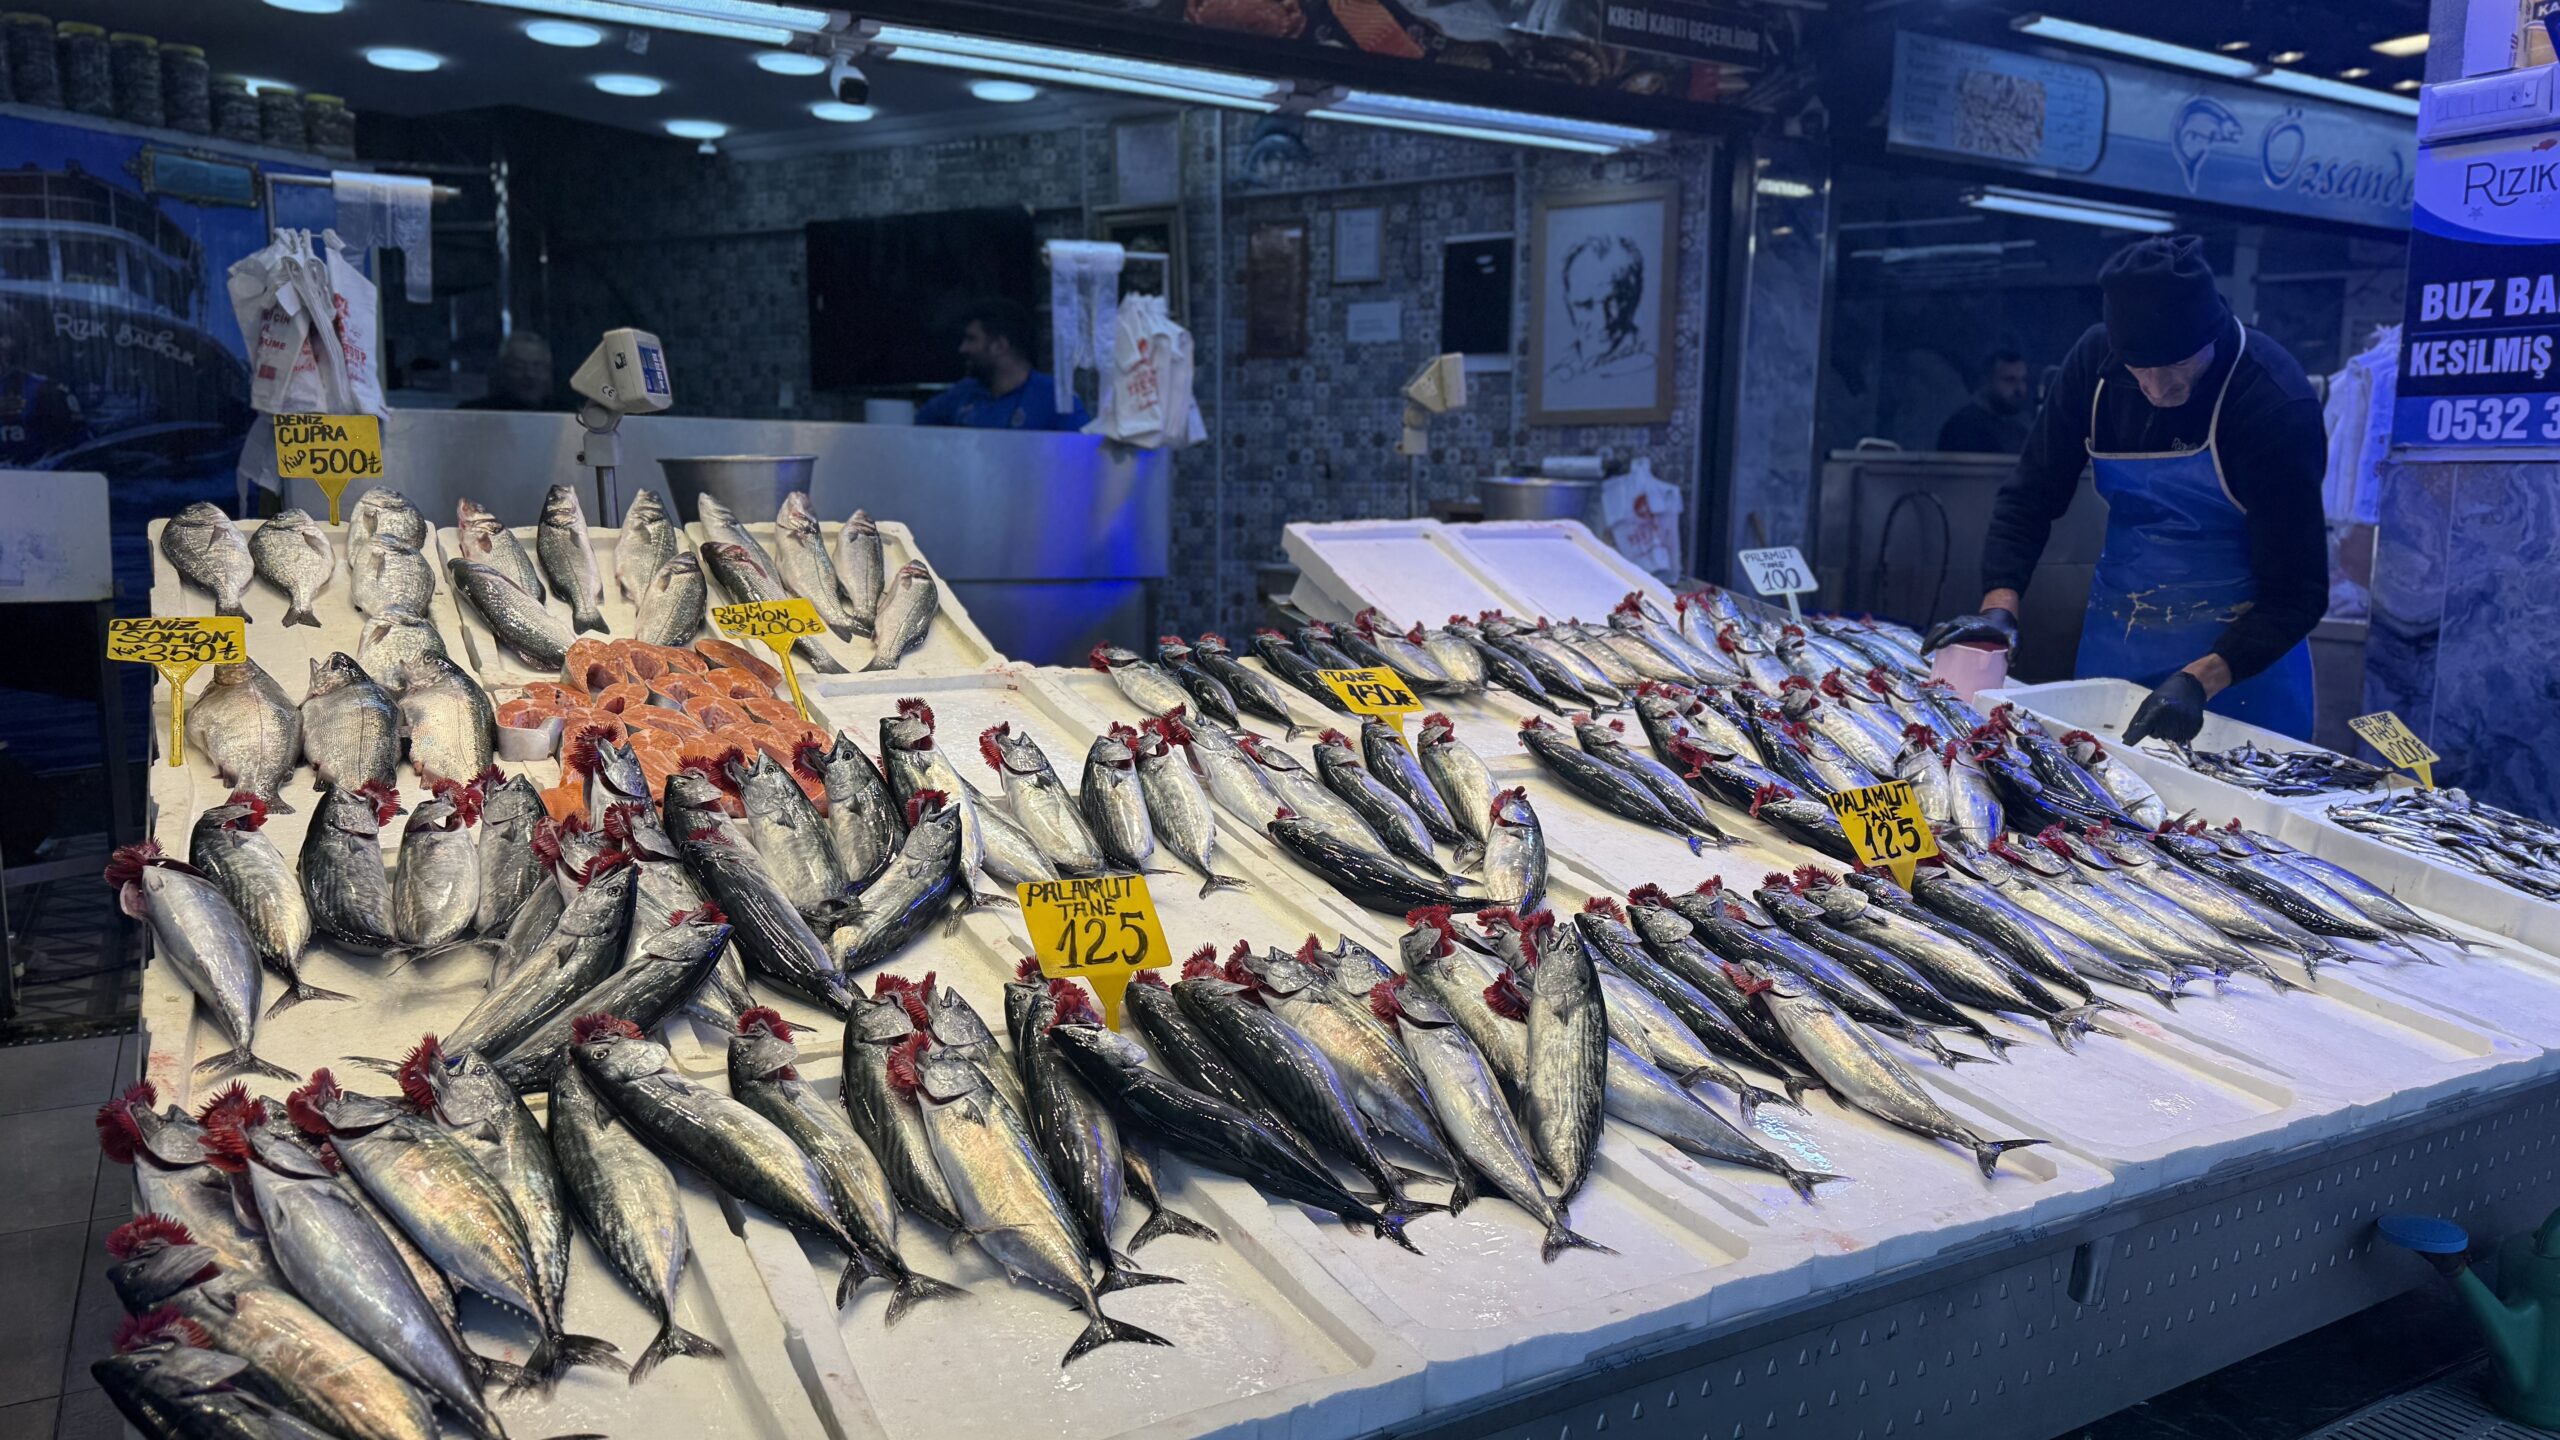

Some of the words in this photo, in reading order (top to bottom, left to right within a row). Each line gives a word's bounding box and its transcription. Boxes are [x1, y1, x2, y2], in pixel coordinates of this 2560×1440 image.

[1607, 5, 1648, 32] KREDİ
[1648, 13, 1688, 38] KARTI
[2463, 162, 2560, 207] RIZIK
[2420, 279, 2496, 322] BUZ
[2504, 274, 2560, 316] BA
[2427, 397, 2530, 441] 0532
[278, 424, 348, 447] ÇUPRA
[1743, 549, 1794, 563] PALAMUT
[1762, 567, 1802, 591] 100
[719, 608, 790, 625] SOMON
[116, 630, 236, 644] SOMON
[1323, 671, 1380, 683] TANE
[1829, 782, 1909, 818] PALAMUT
[1857, 806, 1902, 827] TANE
[1864, 818, 1921, 861] 125
[1026, 875, 1136, 907] PALAMUT
[1054, 898, 1118, 921] TANE
[1055, 910, 1149, 969] 125
